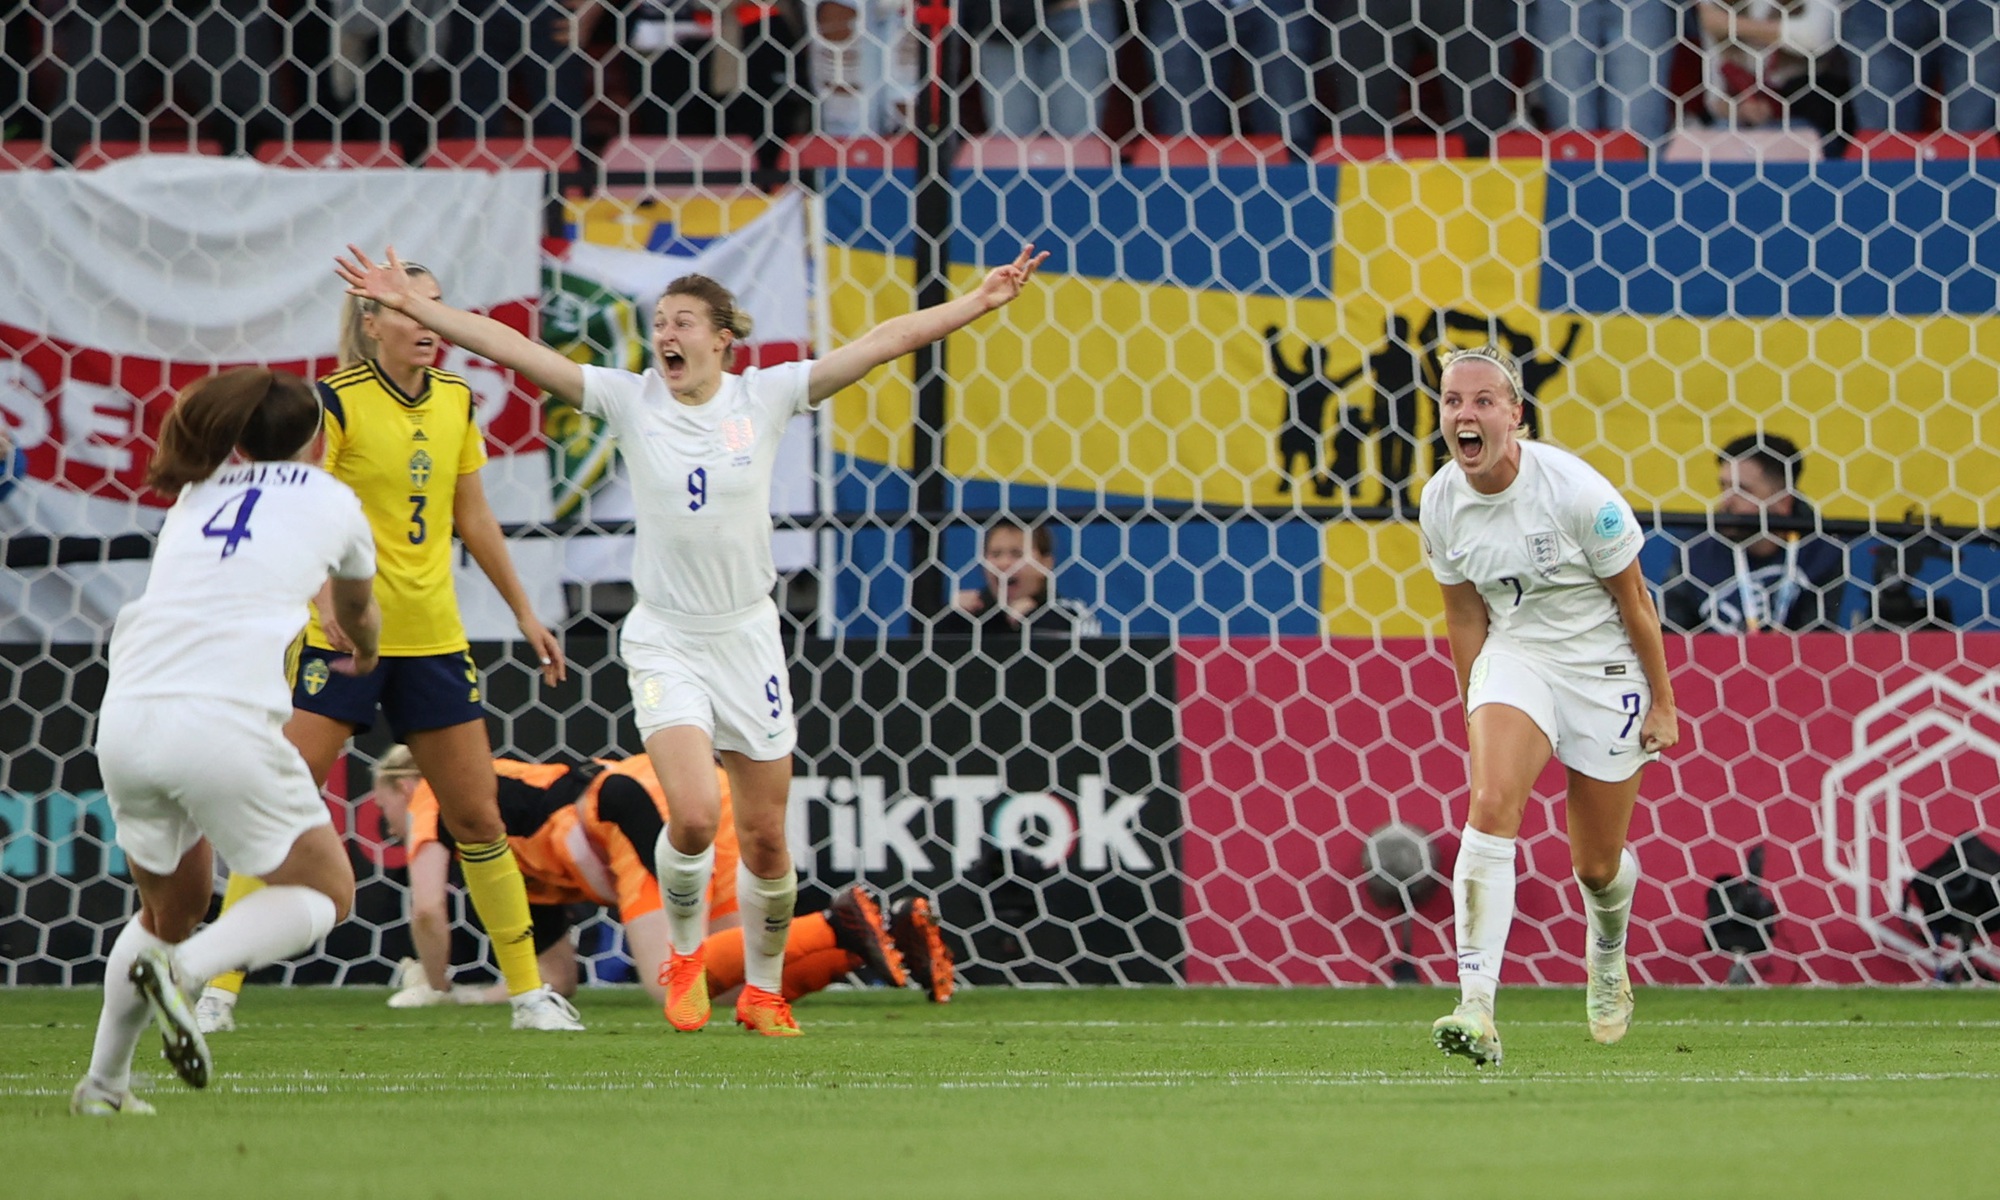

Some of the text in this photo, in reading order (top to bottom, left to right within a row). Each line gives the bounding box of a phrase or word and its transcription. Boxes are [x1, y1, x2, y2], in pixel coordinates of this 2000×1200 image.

[688, 467, 706, 512] 9
[202, 488, 262, 560] 4
[408, 495, 427, 545] 3
[1498, 576, 1524, 607] 7
[765, 674, 783, 719] 9
[1619, 693, 1640, 739] 7
[785, 774, 1155, 873] TikTok
